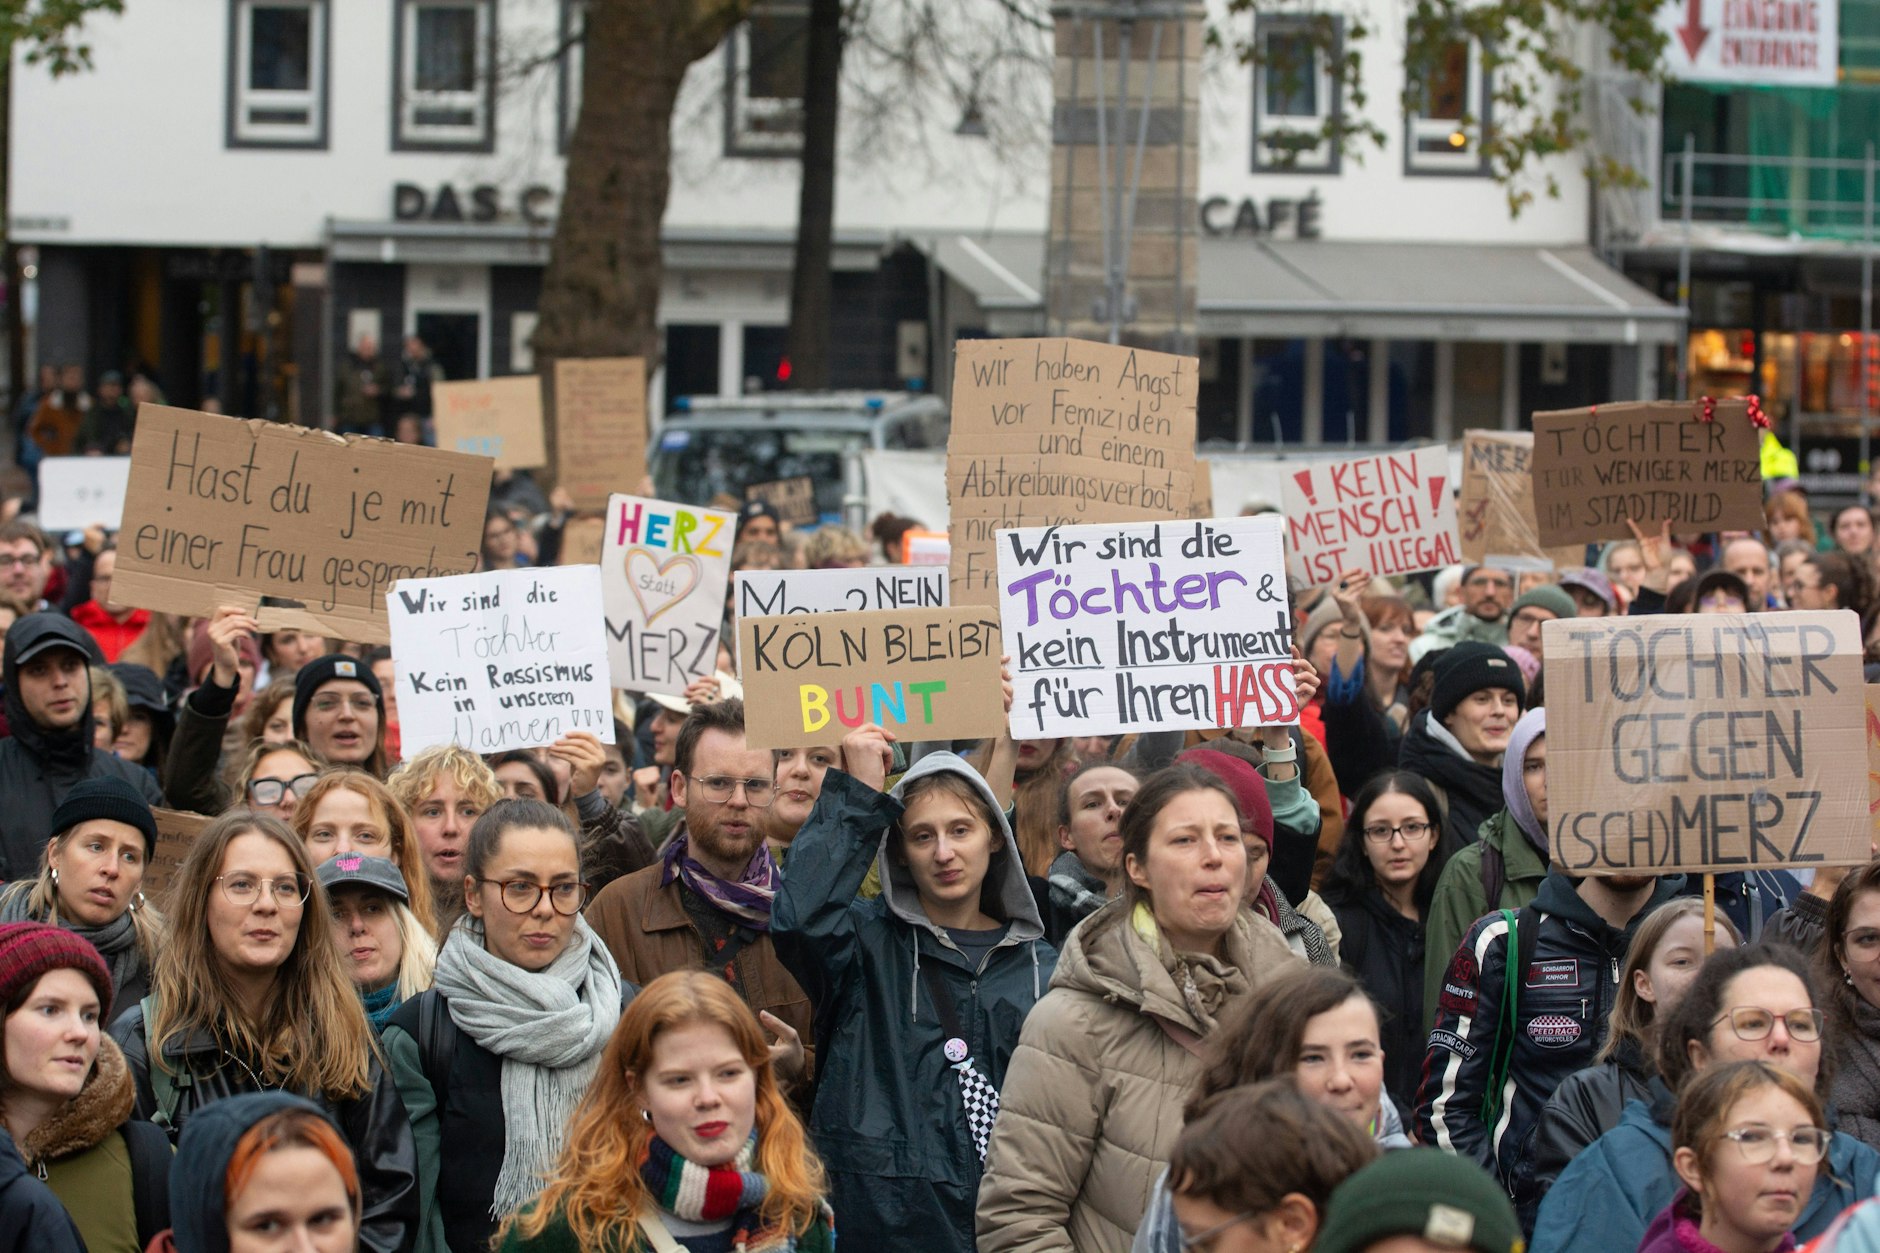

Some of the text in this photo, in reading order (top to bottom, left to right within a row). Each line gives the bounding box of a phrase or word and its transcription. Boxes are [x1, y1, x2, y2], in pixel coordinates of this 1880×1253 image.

[394, 182, 554, 225] DAS C
[1201, 186, 1321, 238] CAFÉ
[1034, 341, 1100, 383] haben
[1117, 350, 1183, 411] Angst
[992, 389, 1171, 436] vor Femiziden
[1038, 426, 1165, 469] und einem
[1546, 421, 1726, 456] TÖCHTER
[167, 429, 456, 539] Hast du je mit
[961, 457, 1180, 517] Abtreibungsverbot,
[1330, 452, 1420, 503] KEIN
[1594, 459, 1693, 486] WENIGER
[1703, 459, 1762, 484] MERZ
[617, 502, 727, 558] HERZ
[1288, 495, 1422, 551] MENSCH
[1548, 490, 1723, 529] IM STADTBILD
[135, 506, 223, 571] einer
[237, 524, 306, 583] Frau
[1008, 521, 1242, 567] Wir sind die
[1303, 531, 1461, 586] IST ILLEGAL
[398, 581, 559, 615] Wir sind die
[875, 573, 943, 609] NEIN
[1007, 562, 1284, 627] Töchter &
[440, 614, 560, 658] Töchter
[604, 616, 718, 685] MERZ
[753, 622, 868, 672] KÖLN
[1017, 610, 1294, 669] kein Instrument
[486, 662, 594, 690] Rassismus
[1568, 624, 1839, 704] TÖCHTER
[454, 695, 476, 713] in
[799, 680, 948, 733] BUNT
[1028, 663, 1300, 732] für Ihren HASS
[1611, 710, 1804, 785] GEGEN
[1555, 790, 1825, 871] (SCH)MERZ
[336, 857, 363, 867] DUMP
[1529, 1026, 1579, 1036] SPEED RACE
[1534, 1035, 1574, 1043] MOTORCYCLES
